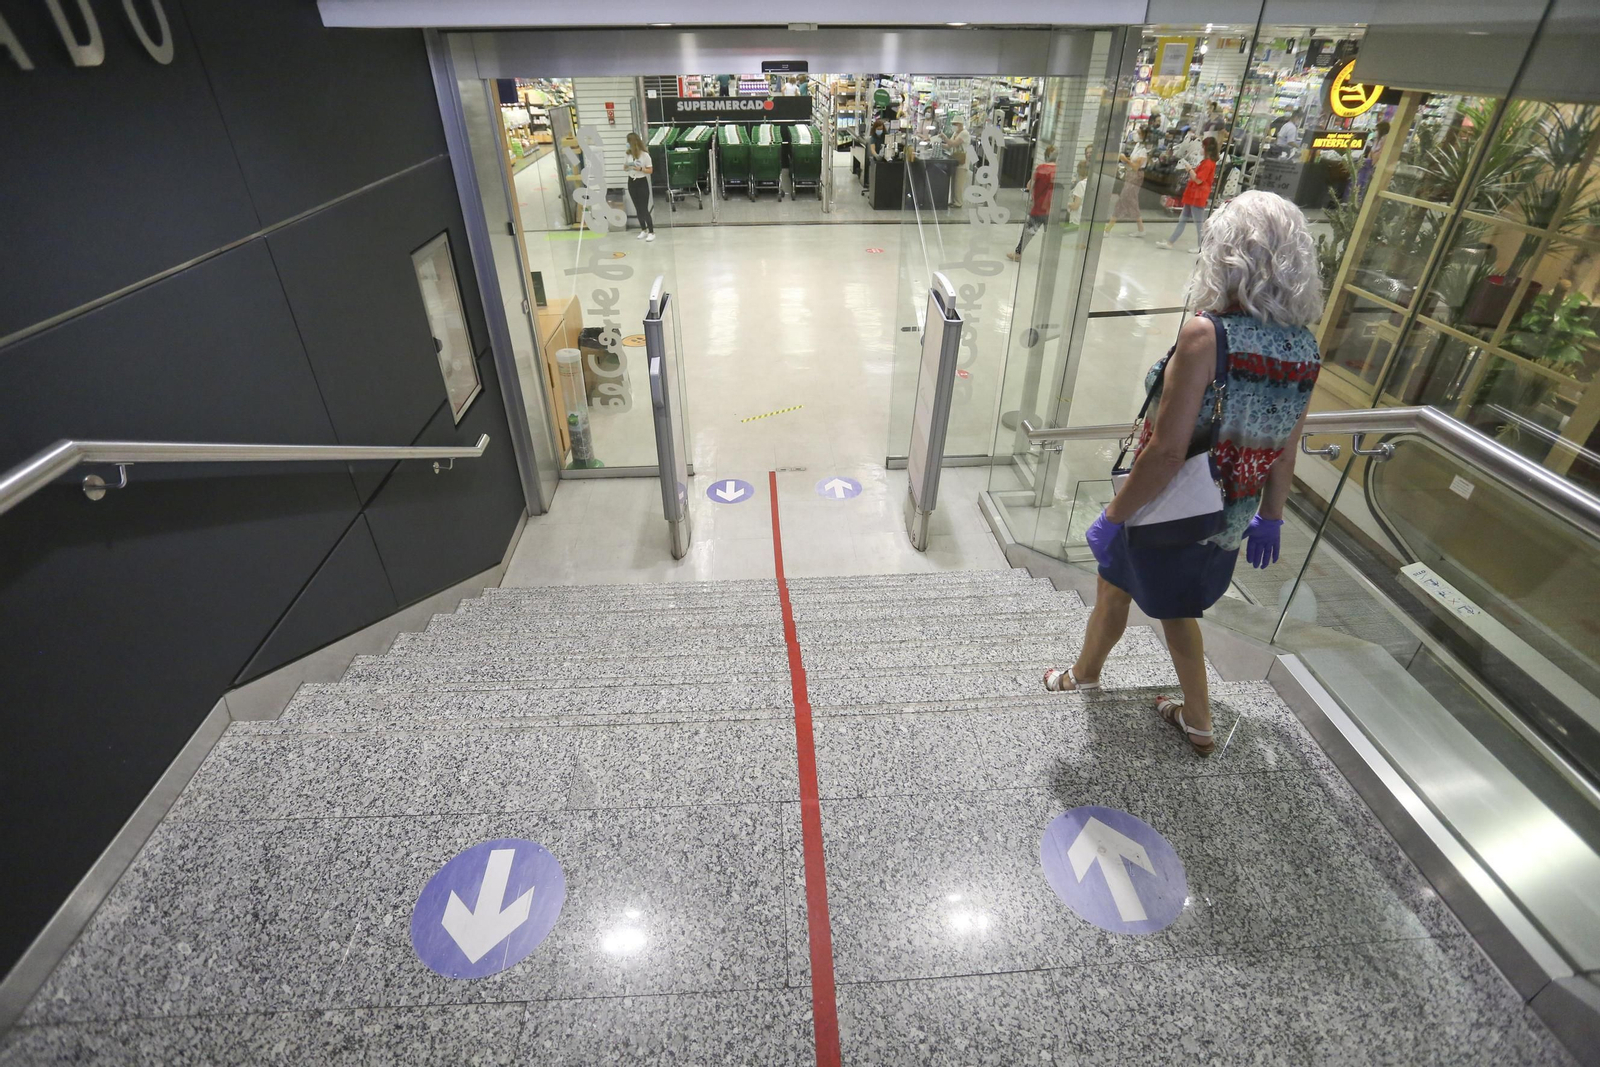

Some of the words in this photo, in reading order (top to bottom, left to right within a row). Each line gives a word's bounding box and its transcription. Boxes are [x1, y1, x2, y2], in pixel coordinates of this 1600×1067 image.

[564, 125, 634, 282] Inglés
[938, 125, 1011, 277] Inglés
[586, 287, 629, 379] Corte
[591, 381, 633, 415] El
